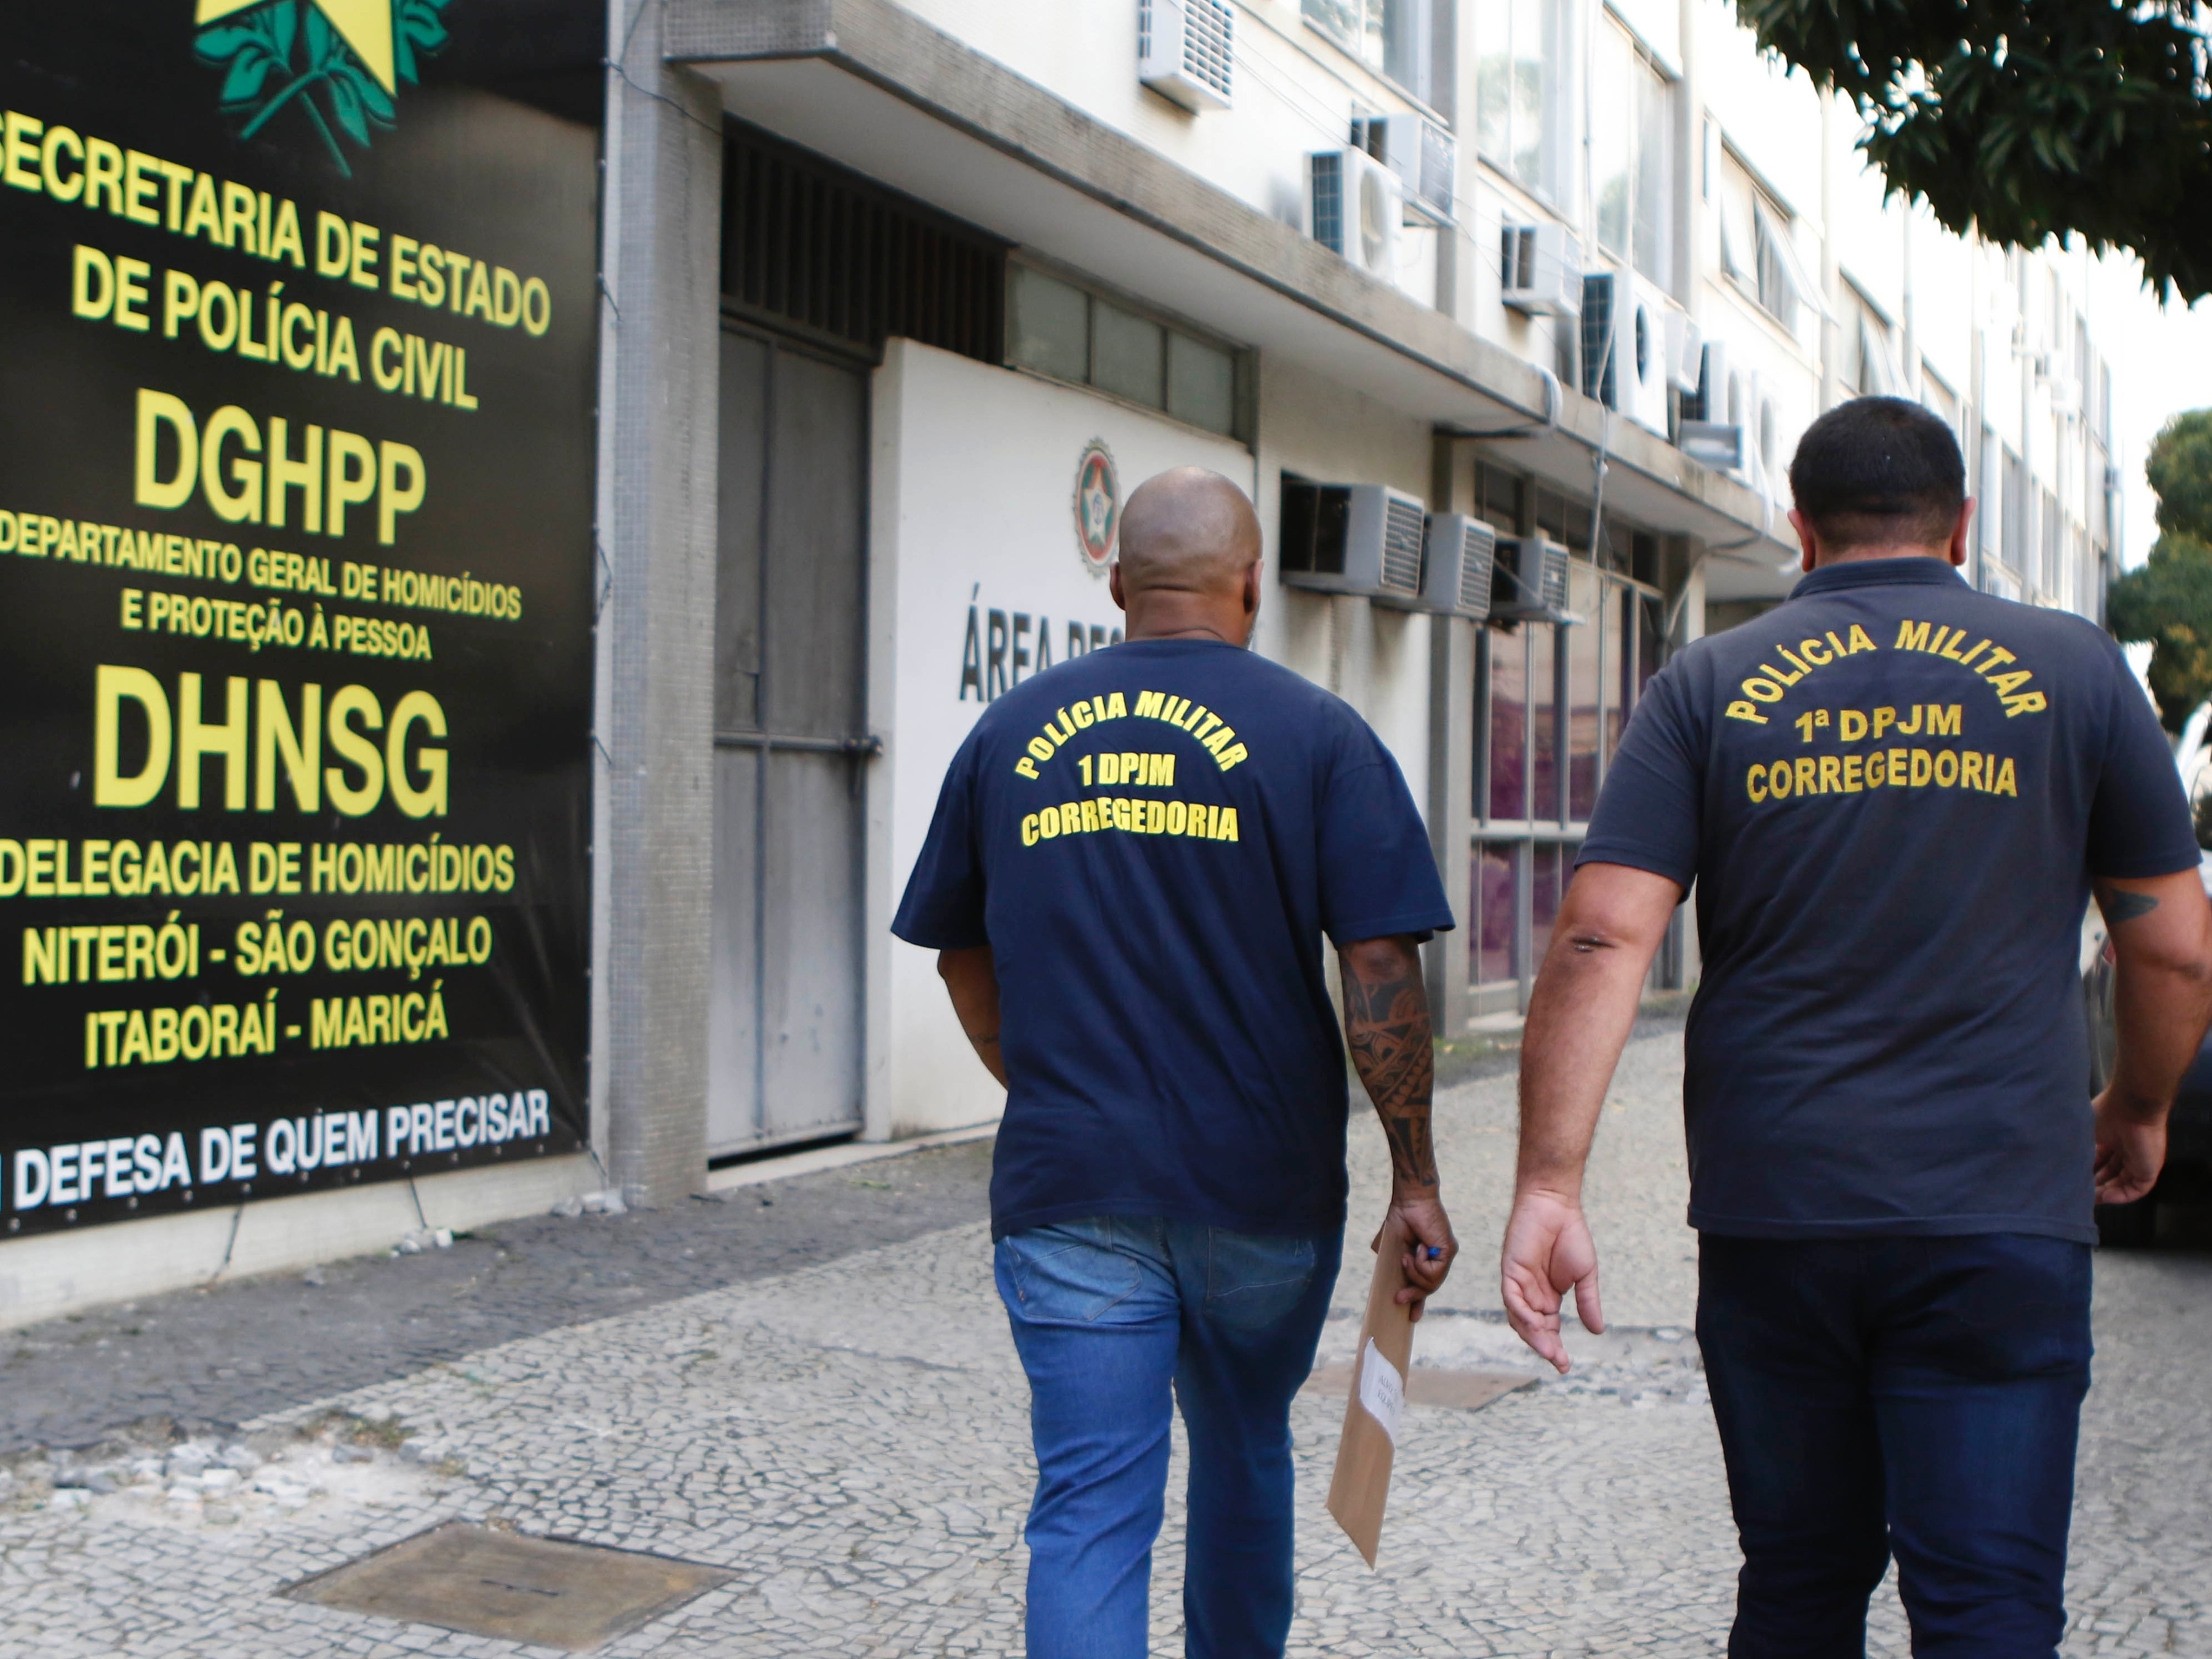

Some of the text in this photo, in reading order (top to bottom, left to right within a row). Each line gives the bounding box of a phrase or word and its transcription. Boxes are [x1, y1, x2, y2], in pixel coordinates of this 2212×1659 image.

[0, 110, 551, 336] ECRETARIA DE ESTADO
[73, 244, 478, 410] DE POLÍCIA CIVIL
[134, 388, 426, 546] DGHPP
[0, 509, 522, 620] DEPARTAMENTO GERAL DE HOMICÍDIOS
[121, 588, 432, 659] E PROTEÇÃO À PESSOA
[959, 581, 1052, 703] ÁREA
[1724, 619, 2048, 725] POLÍCIA MILITAR
[94, 664, 448, 818] DHNSG
[1015, 690, 1248, 780] POLÍCIA MILITAR
[1839, 703, 1963, 742] DPJM
[1077, 752, 1176, 787] 1 DPJM
[1747, 748, 2018, 804] CORREGEDORIA
[0, 832, 515, 897] DELEGACIA DE HOMICÍDIOS
[1021, 796, 1239, 847] CORREGEDORIA
[23, 909, 492, 986] NITERÓI - SÃO GONÇALO
[86, 978, 449, 1068] ITABORAÍ - MARICÁ
[14, 1132, 192, 1211] DEFESA
[200, 1124, 257, 1184] DE
[265, 1108, 378, 1175] QUEM
[387, 1089, 551, 1158] PRECISAR
